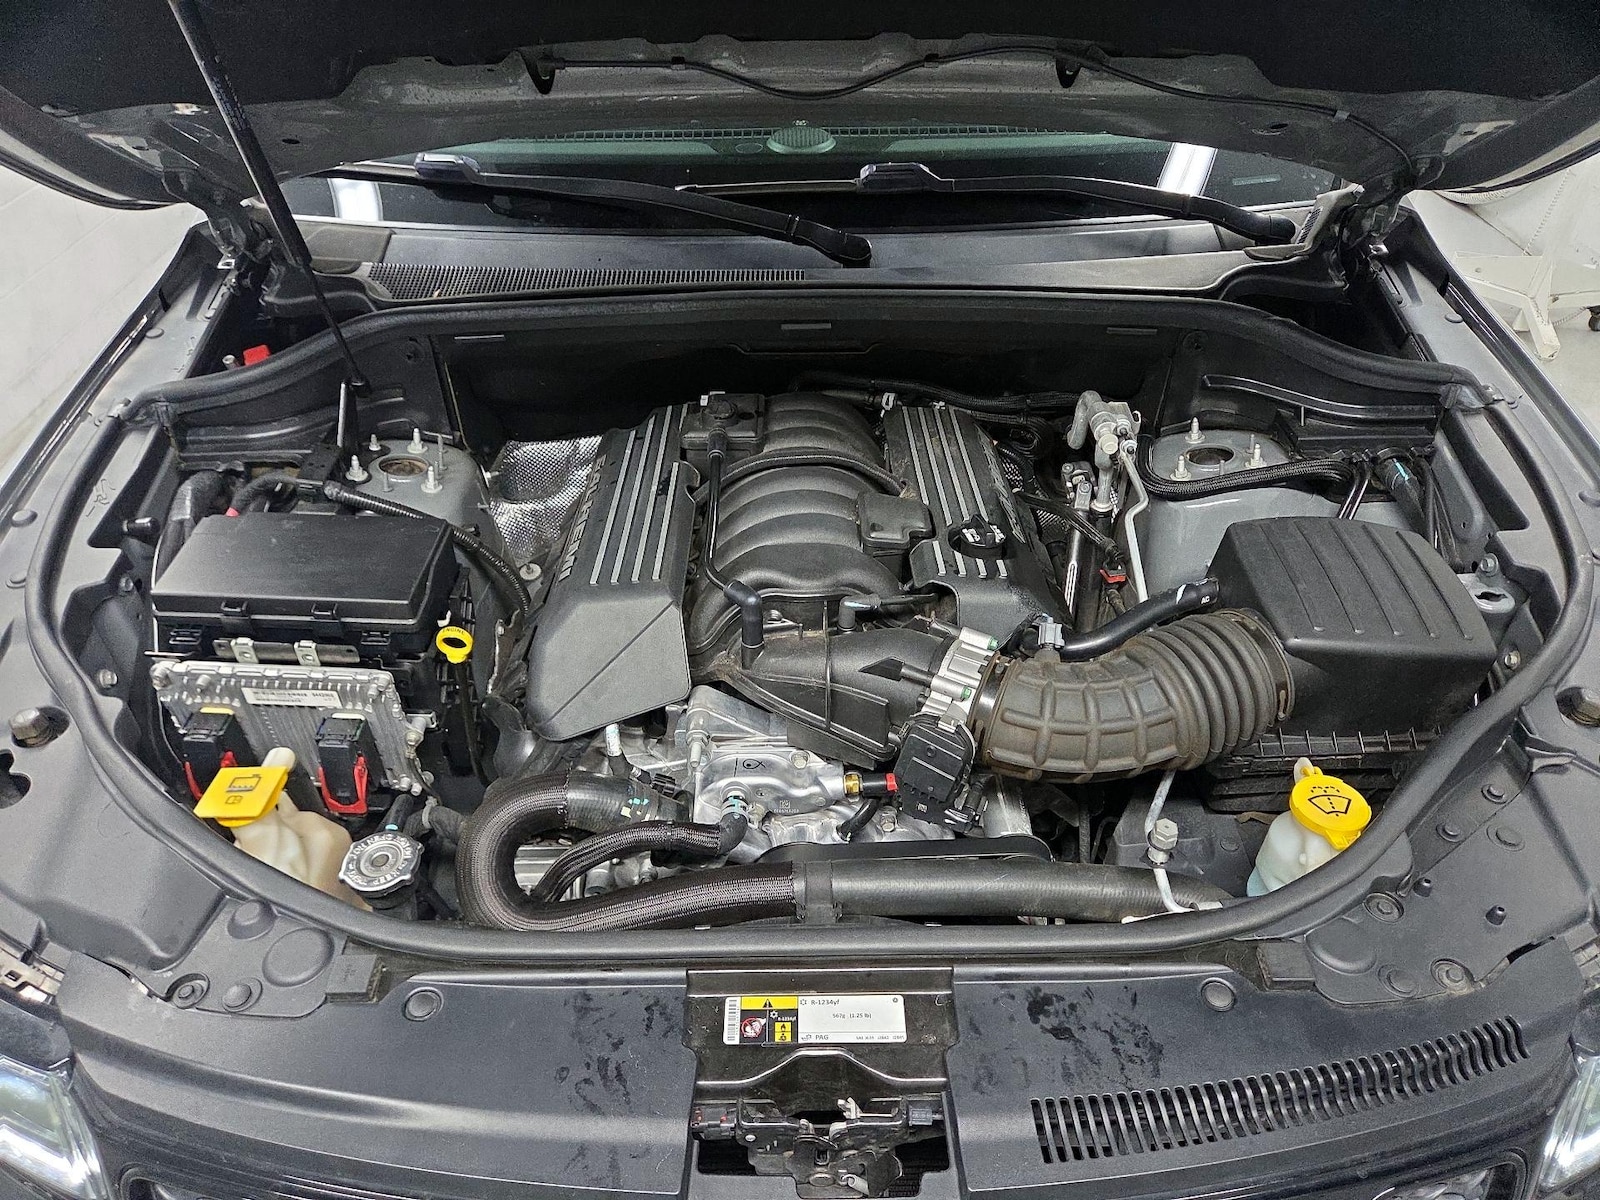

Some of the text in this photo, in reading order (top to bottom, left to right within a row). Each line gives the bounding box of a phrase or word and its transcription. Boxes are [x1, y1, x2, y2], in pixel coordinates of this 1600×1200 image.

[559, 500, 594, 582] HEMI
[442, 627, 466, 635] ENGINE
[373, 868, 401, 886] KEEP
